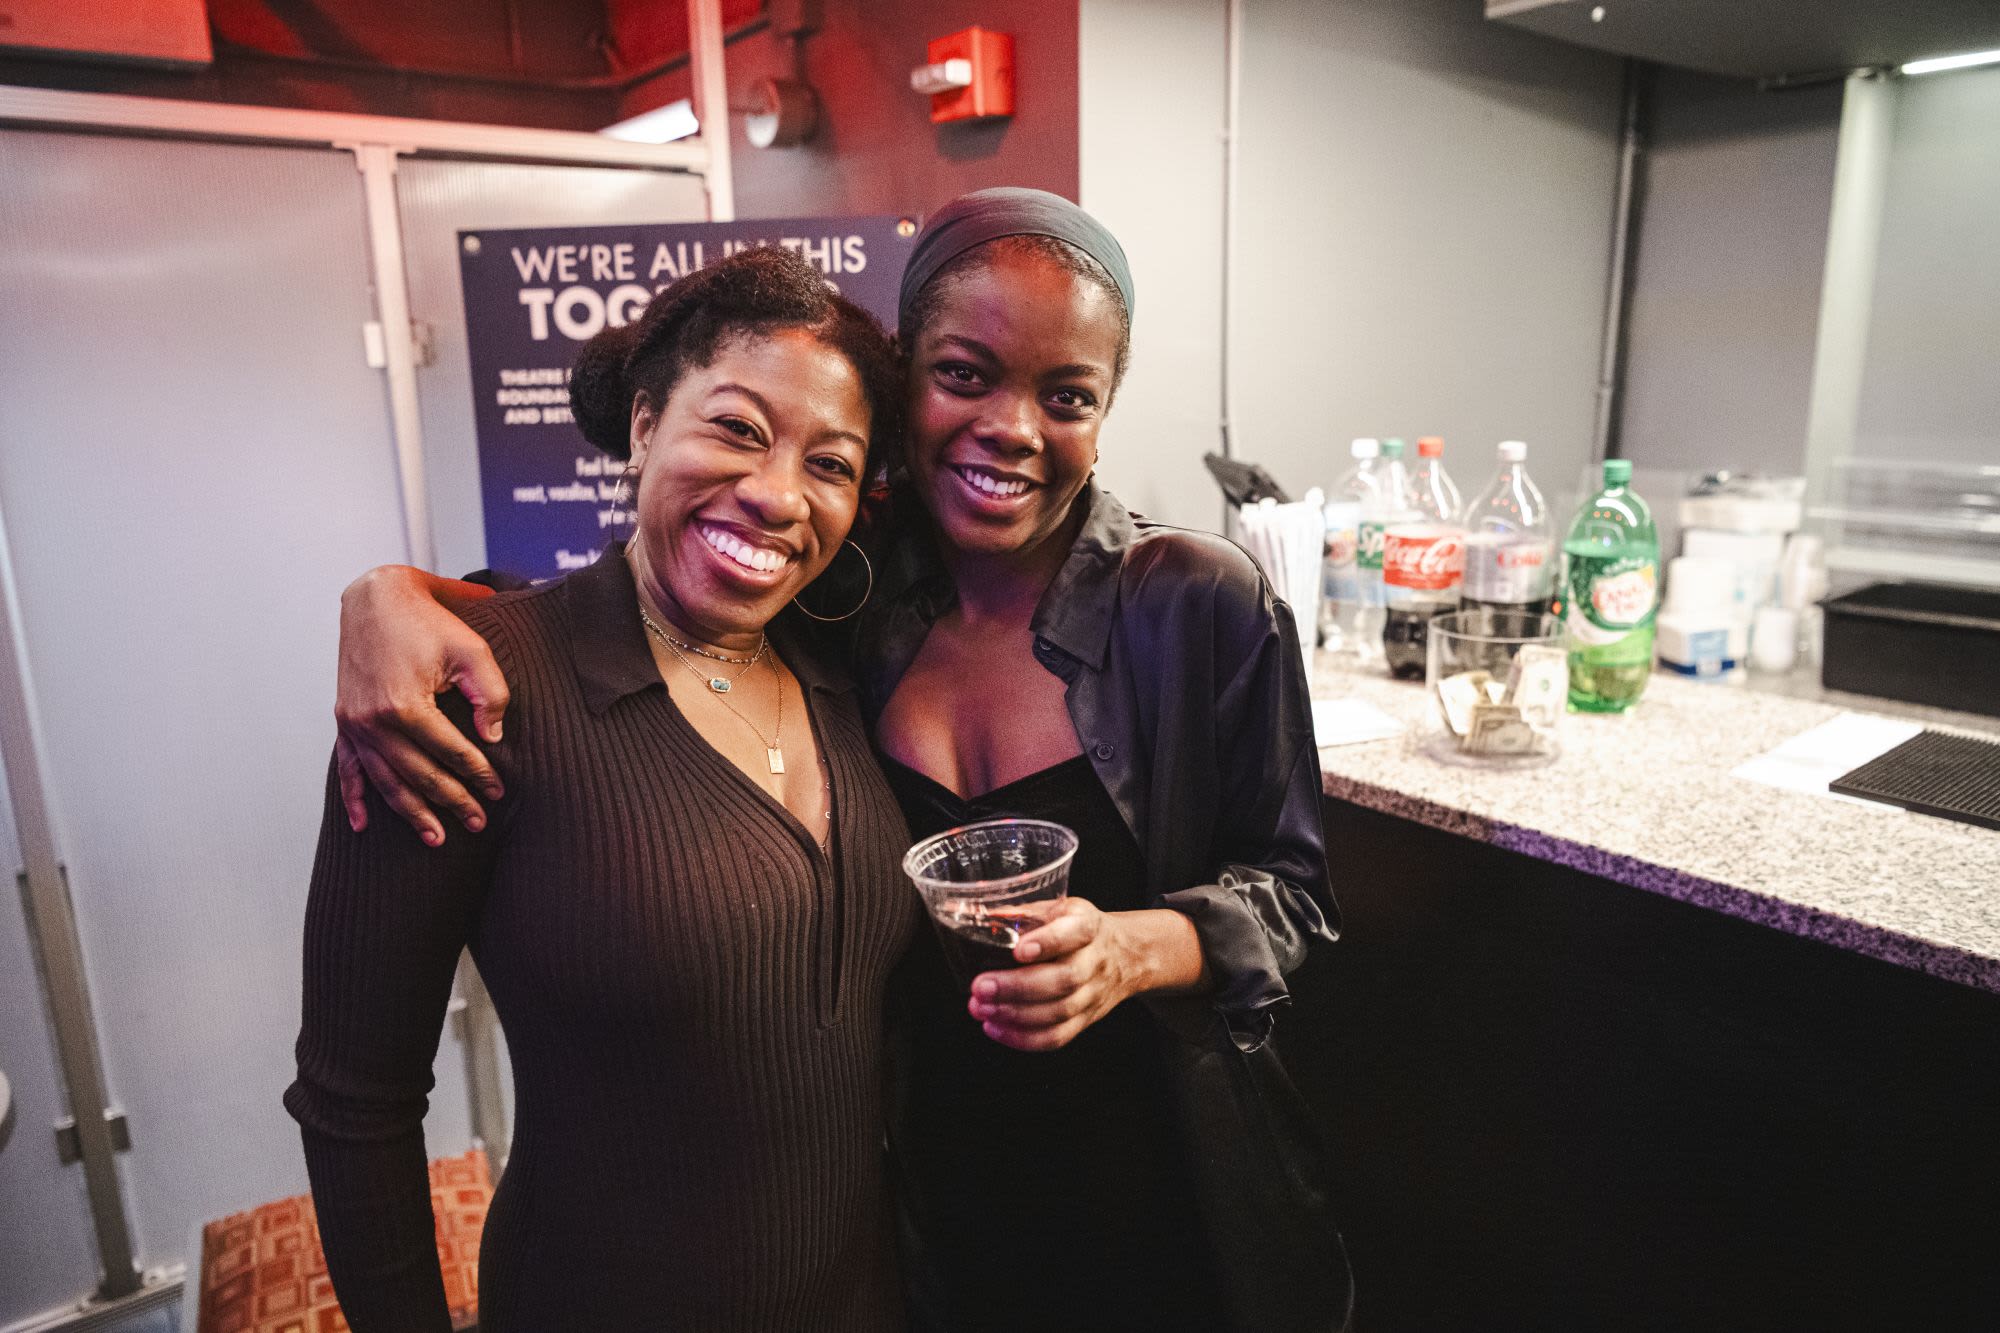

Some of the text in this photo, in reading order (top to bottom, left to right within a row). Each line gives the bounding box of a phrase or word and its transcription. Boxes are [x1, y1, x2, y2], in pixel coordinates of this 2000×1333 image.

[511, 242, 636, 283] WE'RE
[648, 240, 703, 280] ALL
[504, 407, 541, 425] AND
